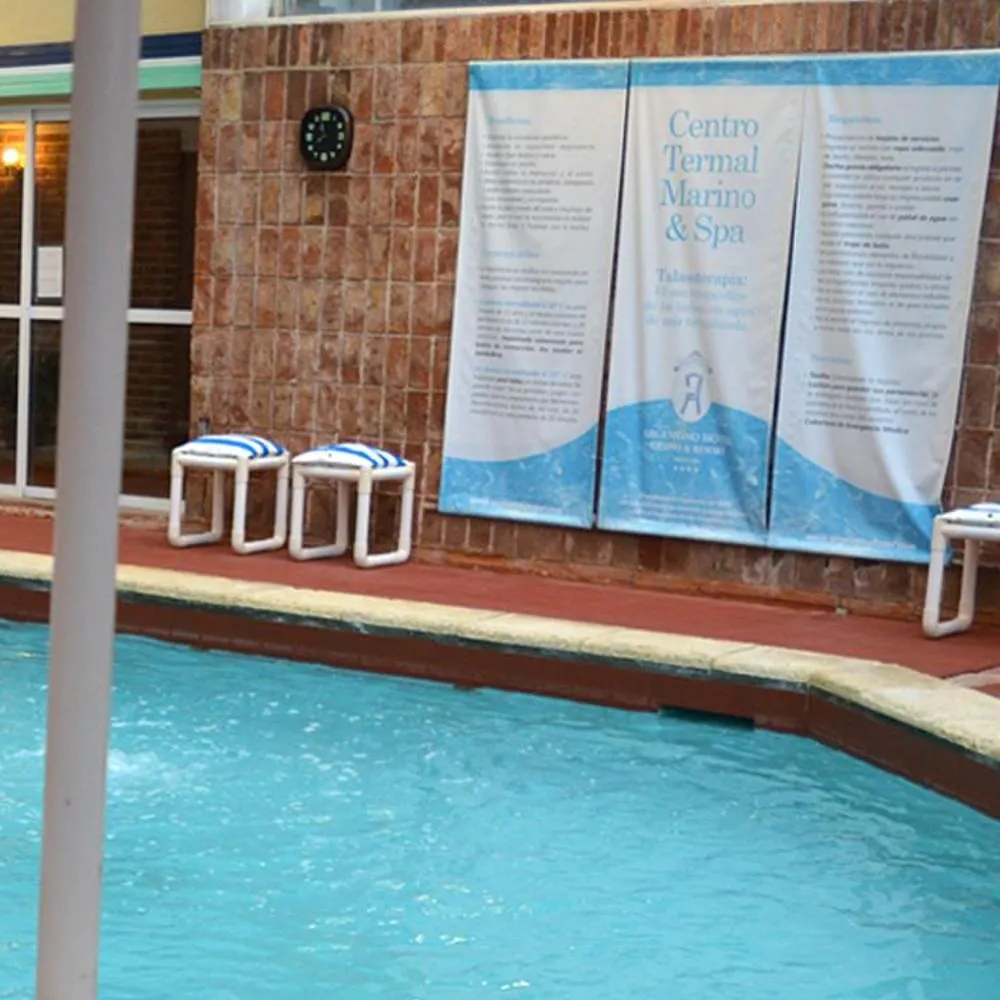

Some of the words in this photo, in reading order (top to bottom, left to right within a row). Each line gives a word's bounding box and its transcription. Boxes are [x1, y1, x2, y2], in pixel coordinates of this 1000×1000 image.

[669, 109, 759, 138] Centro
[663, 144, 759, 173] Termal
[660, 179, 756, 209] Marino
[665, 213, 687, 242] &
[694, 212, 745, 249] Spa
